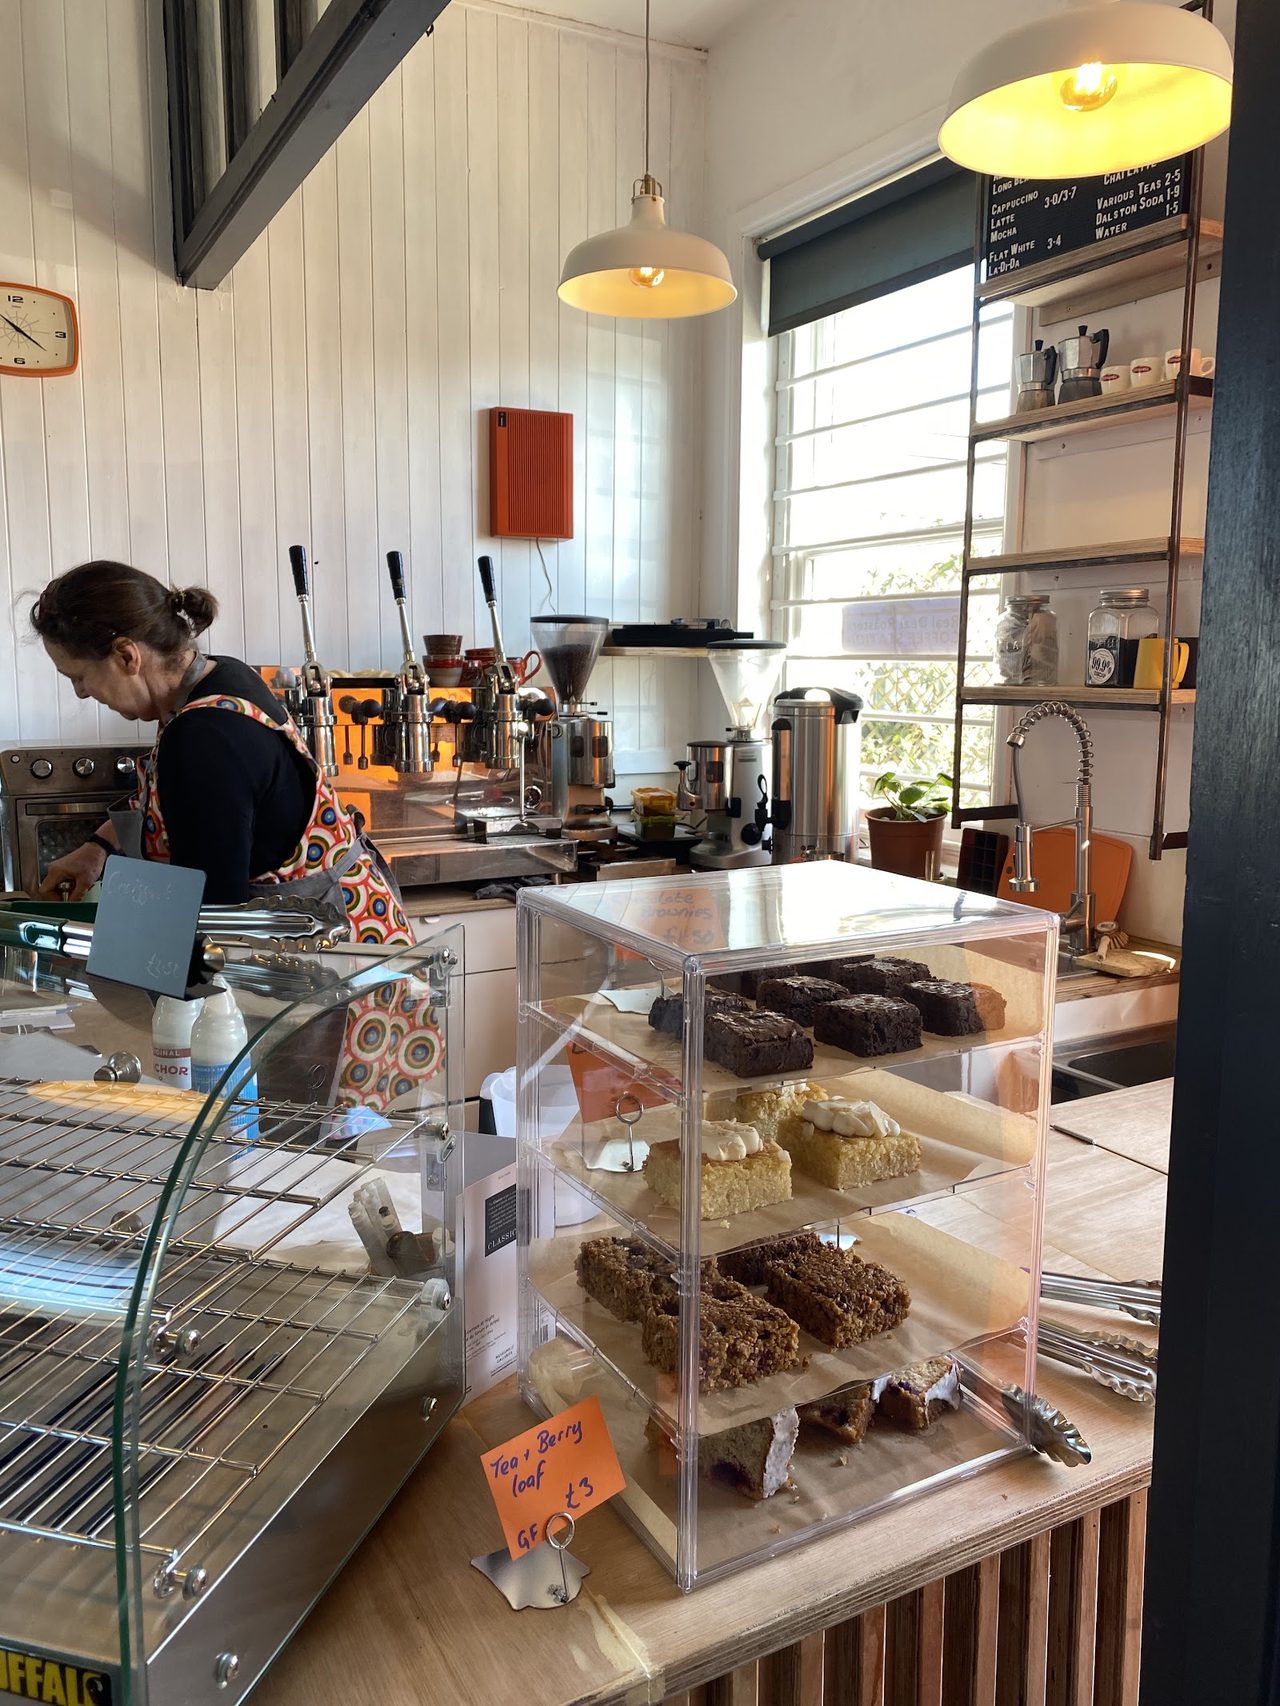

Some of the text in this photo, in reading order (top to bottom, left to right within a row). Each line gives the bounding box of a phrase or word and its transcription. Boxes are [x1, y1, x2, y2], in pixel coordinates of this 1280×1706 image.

[993, 180, 1013, 195] LONG
[1097, 189, 1134, 210] VARIOUS
[1138, 179, 1162, 195] TEAS
[991, 190, 1039, 215] CAPPUCCINO
[1096, 203, 1137, 225] DALSTON
[1140, 194, 1164, 210] SODA
[990, 213, 1015, 230] LATTE
[1095, 222, 1128, 240] WATER
[990, 226, 1017, 243] MOCHA
[989, 249, 1009, 263] FLAT
[1011, 240, 1036, 255] WHITE
[7, 294, 24, 304] 12
[54, 331, 67, 339] 3
[13, 357, 26, 365] 6
[490, 1455, 519, 1478] Tea
[537, 1420, 583, 1455] Berry
[512, 1459, 546, 1498] loaf
[517, 1522, 539, 1550] GF
